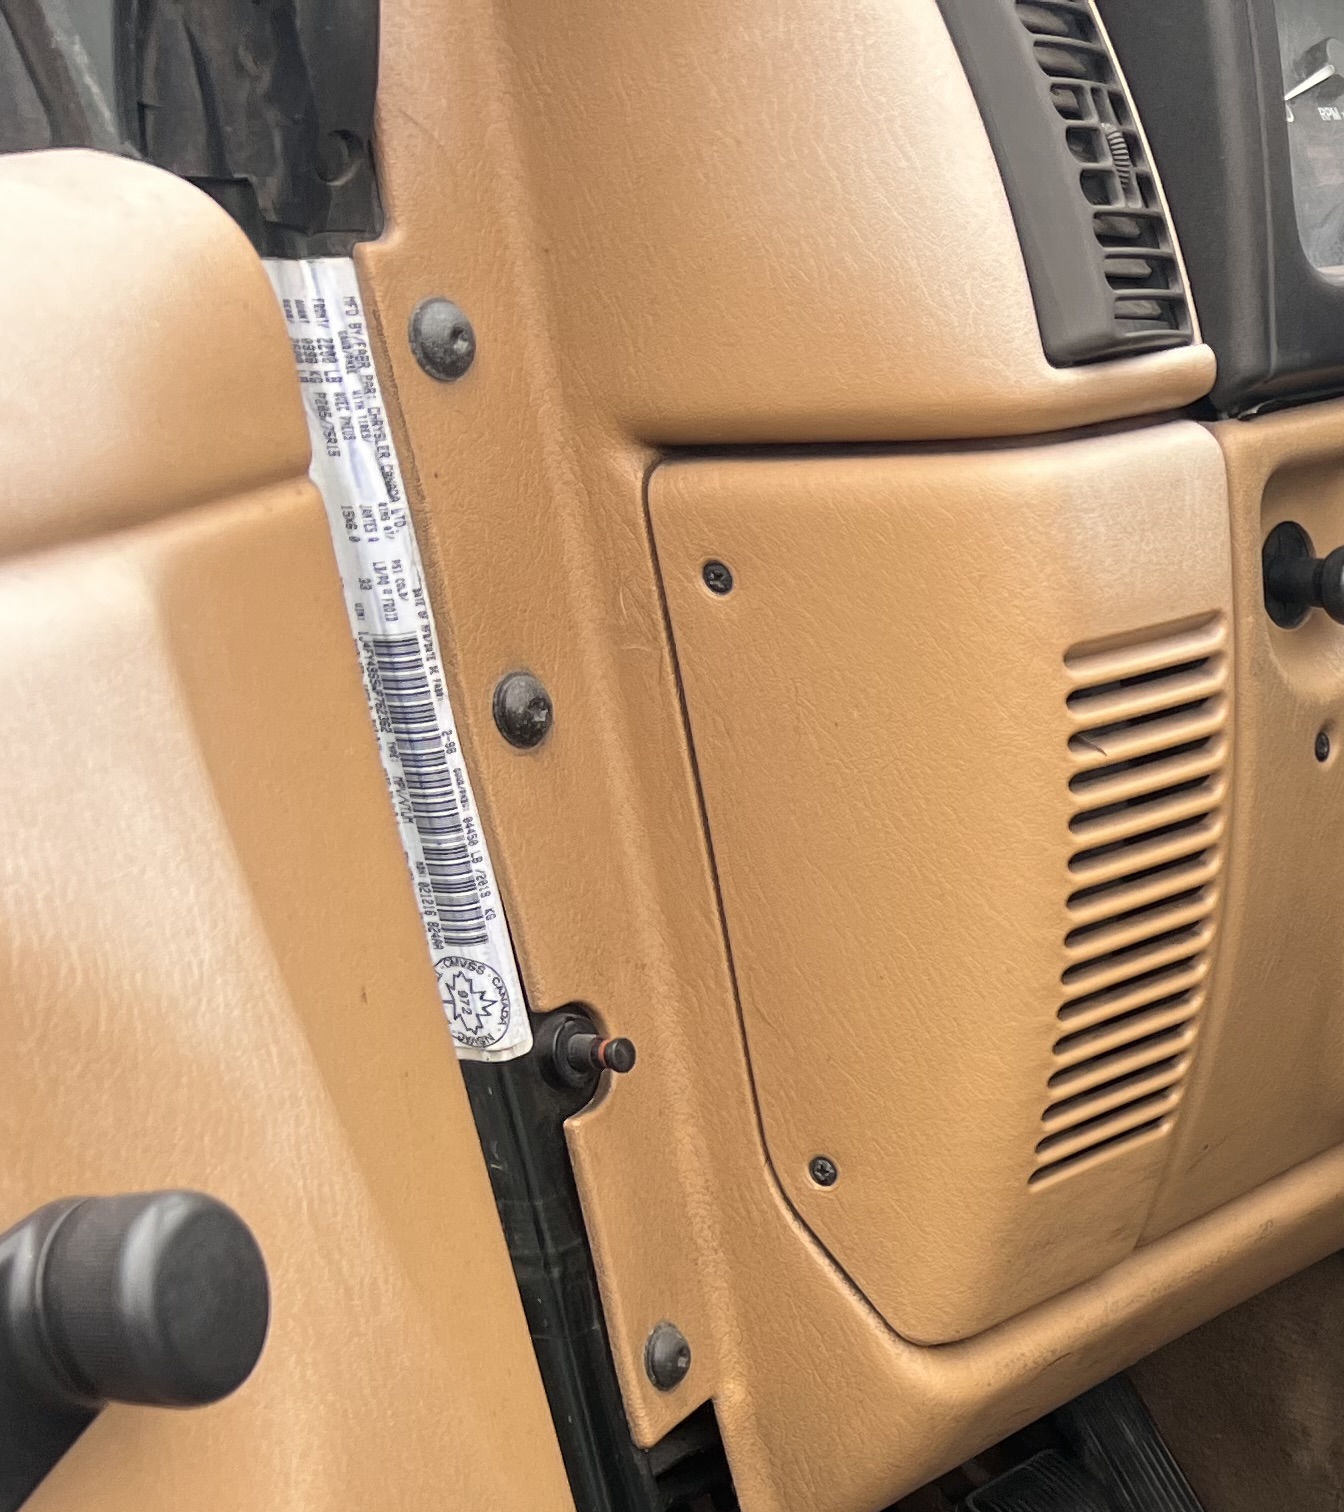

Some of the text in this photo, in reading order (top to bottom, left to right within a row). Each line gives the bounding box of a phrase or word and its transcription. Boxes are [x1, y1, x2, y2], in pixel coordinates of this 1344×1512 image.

[368, 407, 390, 458] CHRYSLER
[470, 851, 483, 862] LB
[484, 908, 496, 920] KG
[492, 976, 511, 1026] CANADA
